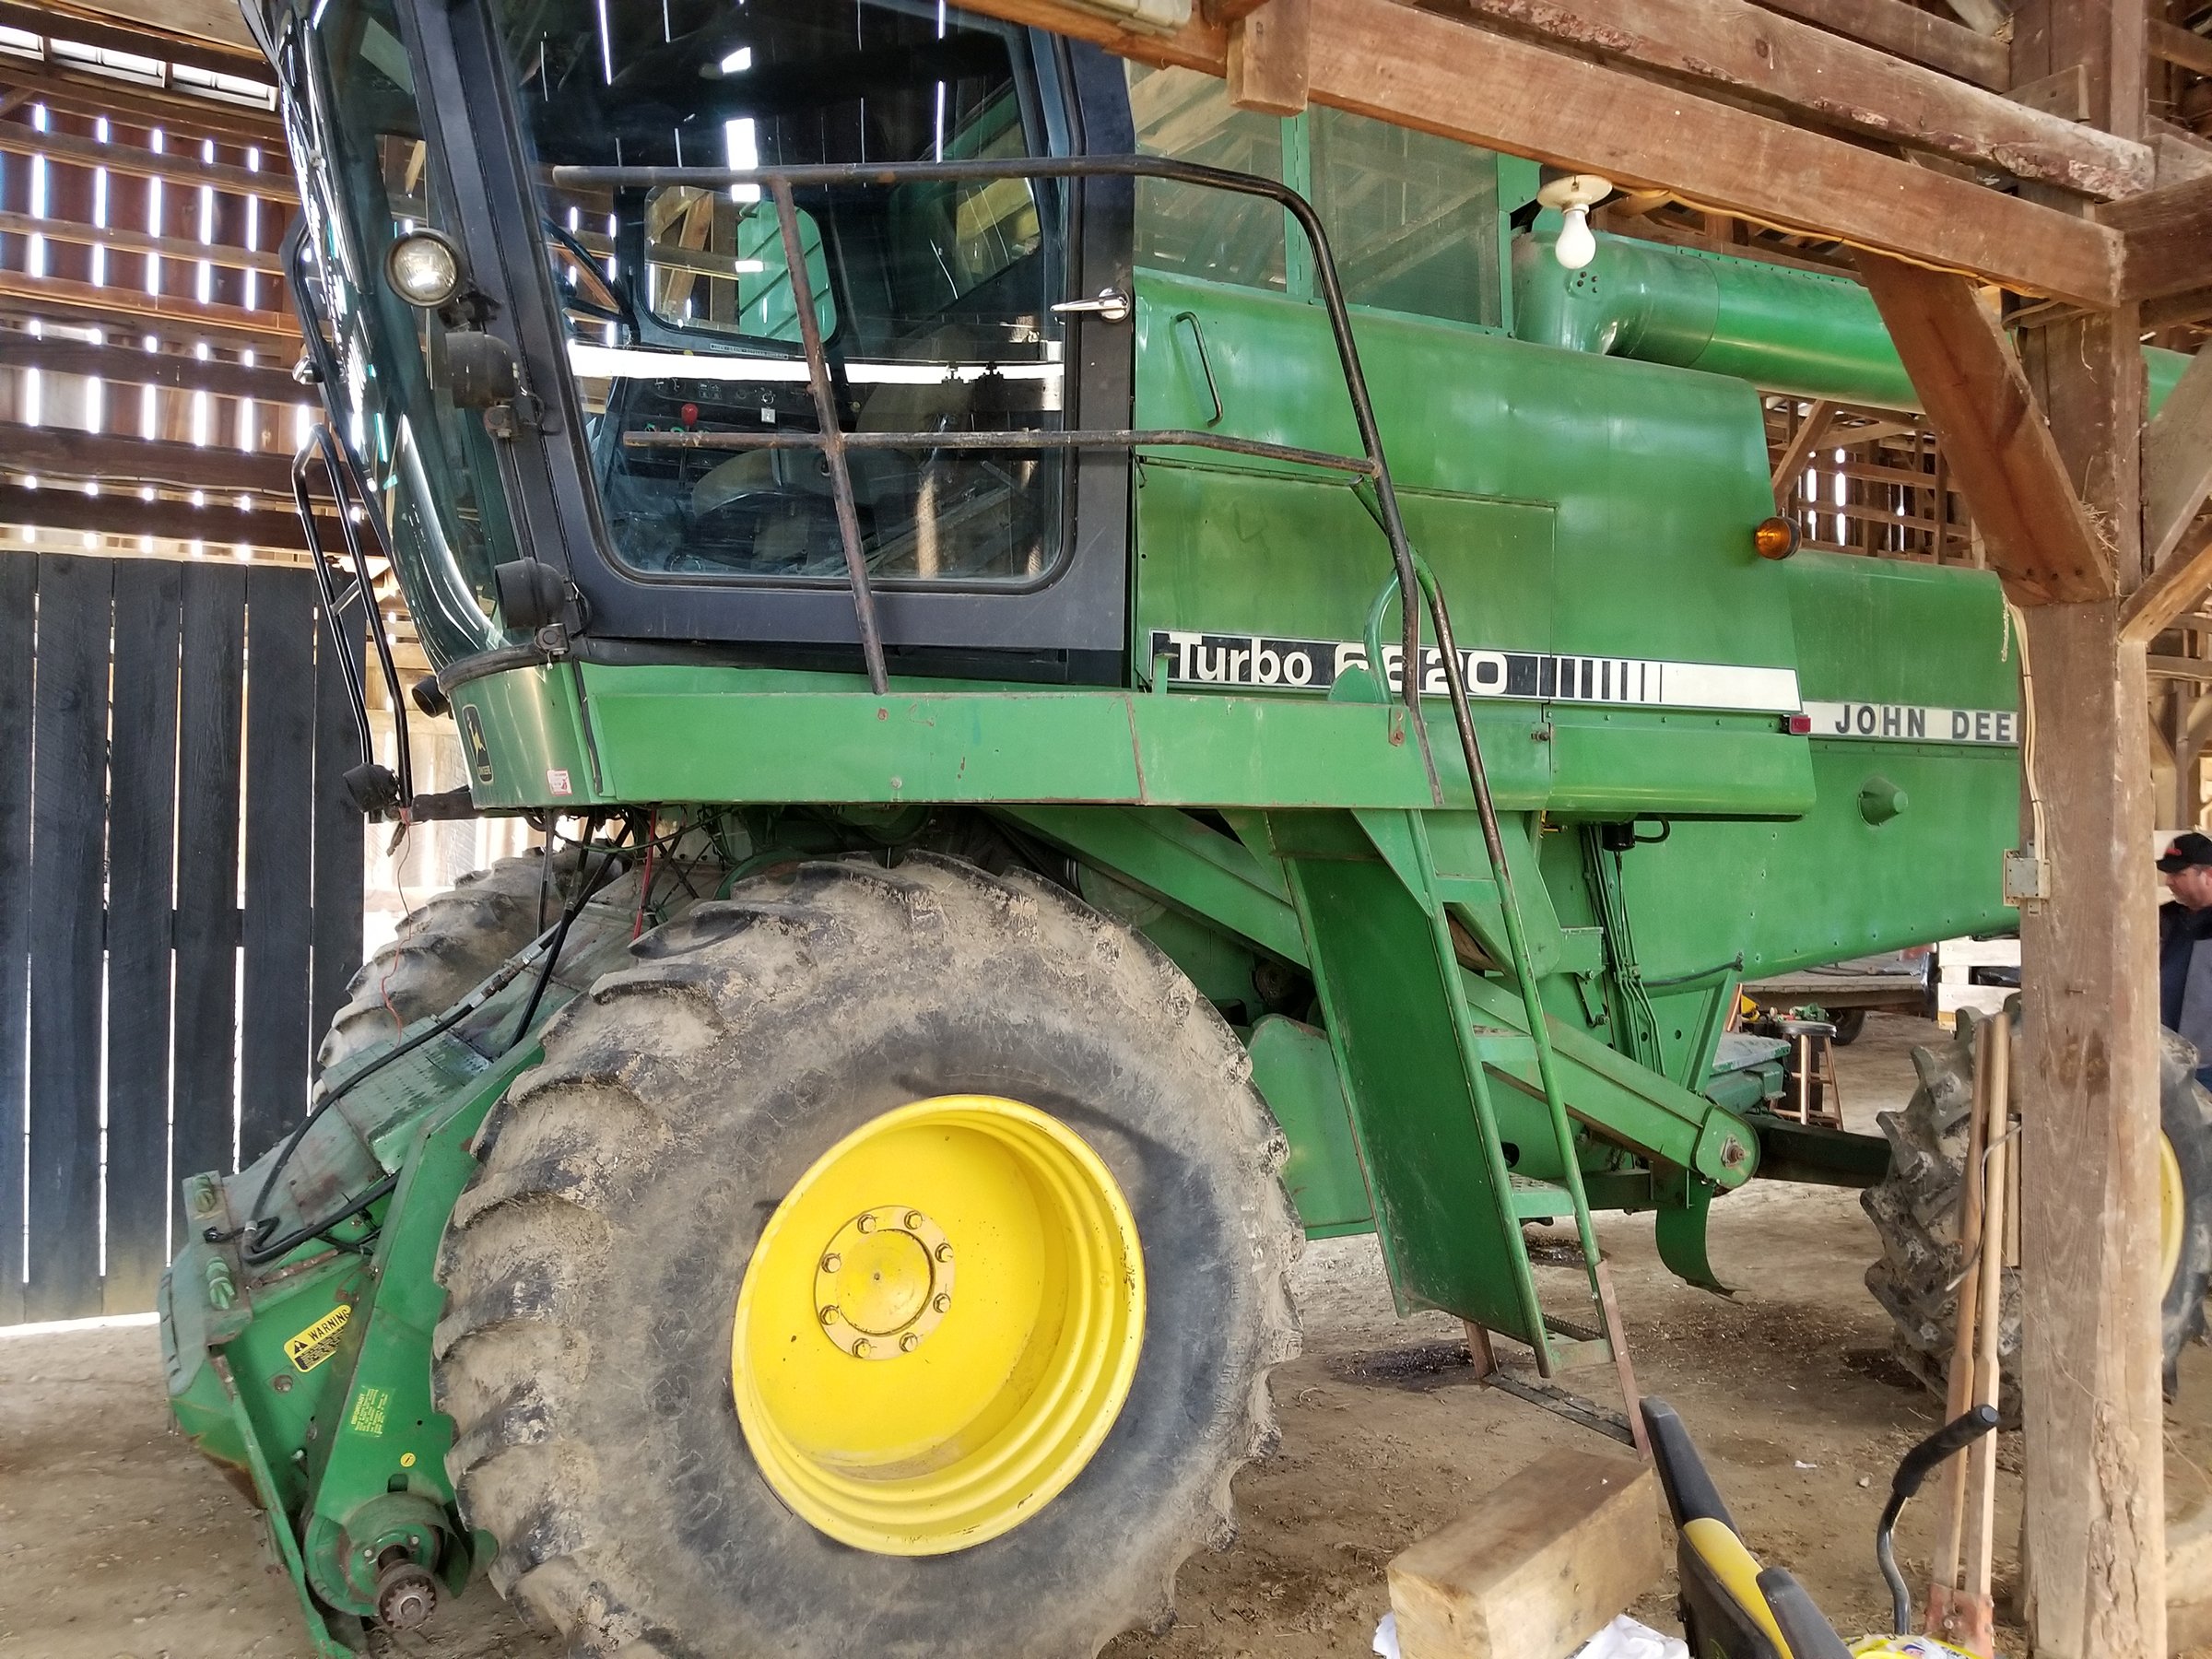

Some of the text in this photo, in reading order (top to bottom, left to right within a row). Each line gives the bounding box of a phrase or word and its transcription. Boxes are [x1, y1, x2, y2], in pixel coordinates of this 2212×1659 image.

[1168, 631, 1313, 686] Turbo
[1834, 704, 1926, 738] JOHN
[307, 1308, 351, 1342] WARNING
